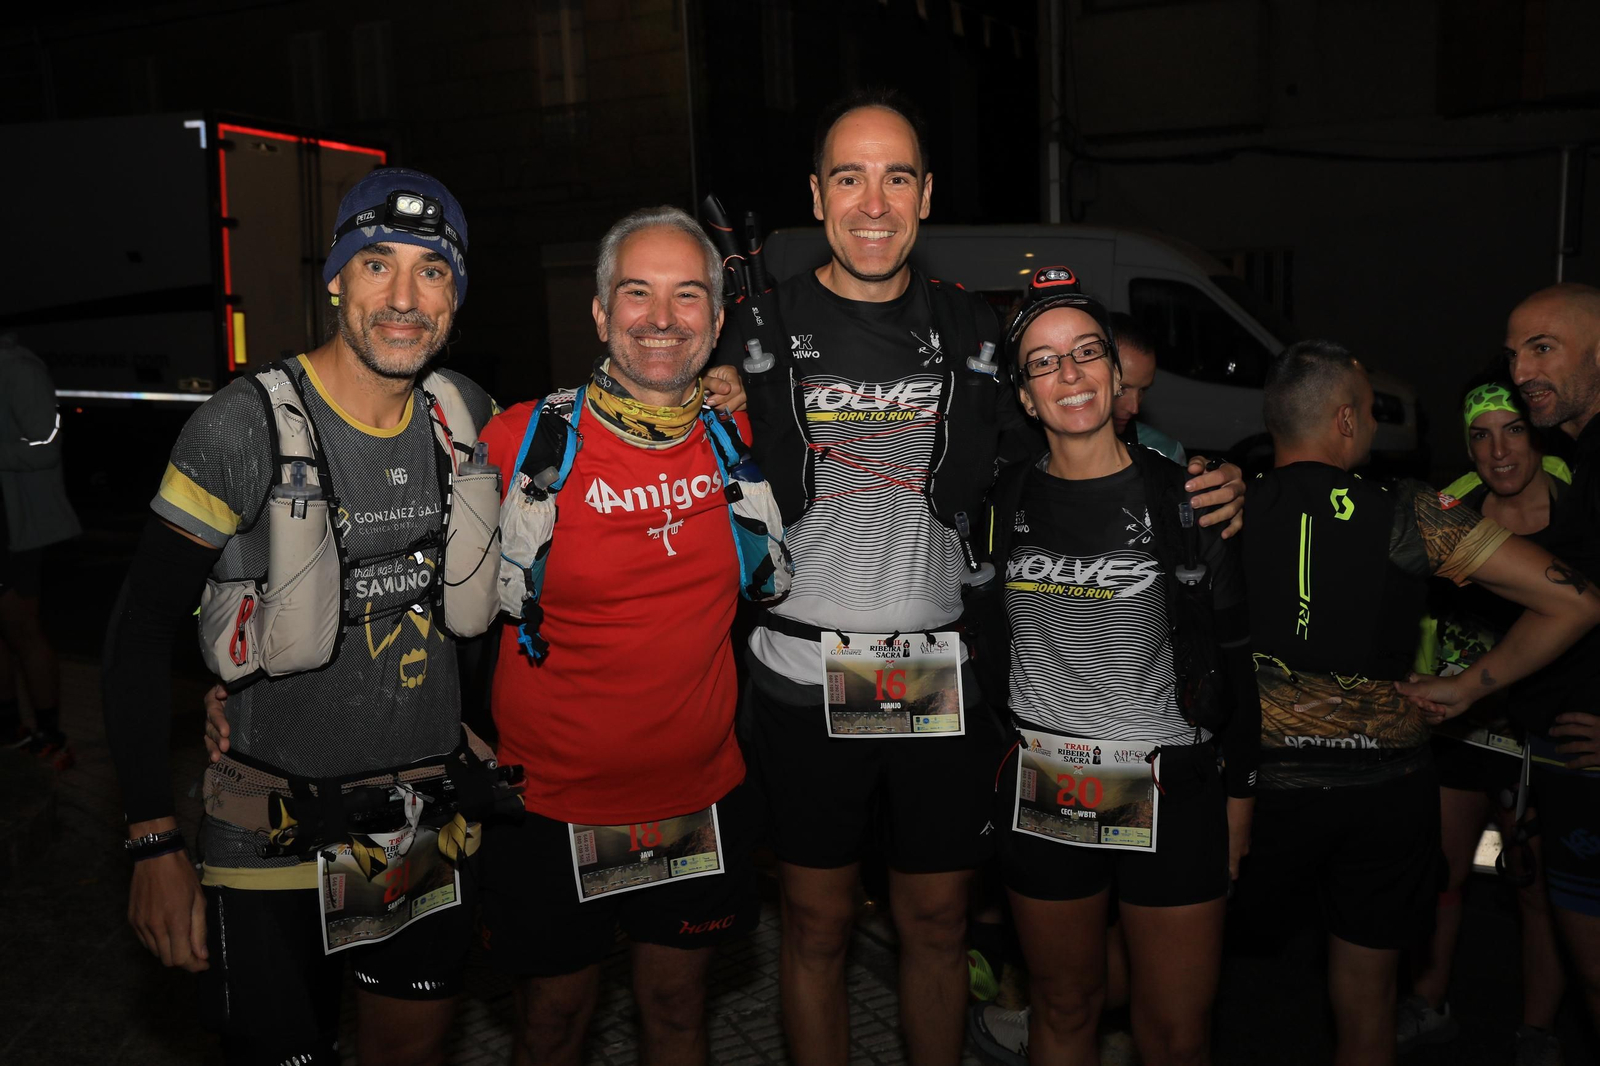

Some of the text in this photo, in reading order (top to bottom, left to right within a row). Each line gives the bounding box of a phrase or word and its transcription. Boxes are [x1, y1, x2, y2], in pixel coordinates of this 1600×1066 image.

[356, 211, 376, 225] PETZL
[584, 470, 723, 514] 4Amigos
[875, 651, 901, 659] SACRA
[873, 668, 907, 701] 16
[1057, 748, 1091, 758] RIBEIRA
[1064, 742, 1091, 751] TRAIL
[1063, 756, 1090, 765] SACRA
[1056, 773, 1104, 809] 20
[1060, 807, 1073, 816] CECI
[1078, 809, 1097, 819] WBTR
[628, 821, 663, 852] 18
[639, 850, 654, 859] JAVI
[383, 860, 411, 904] 21
[678, 914, 736, 935] HOKO
